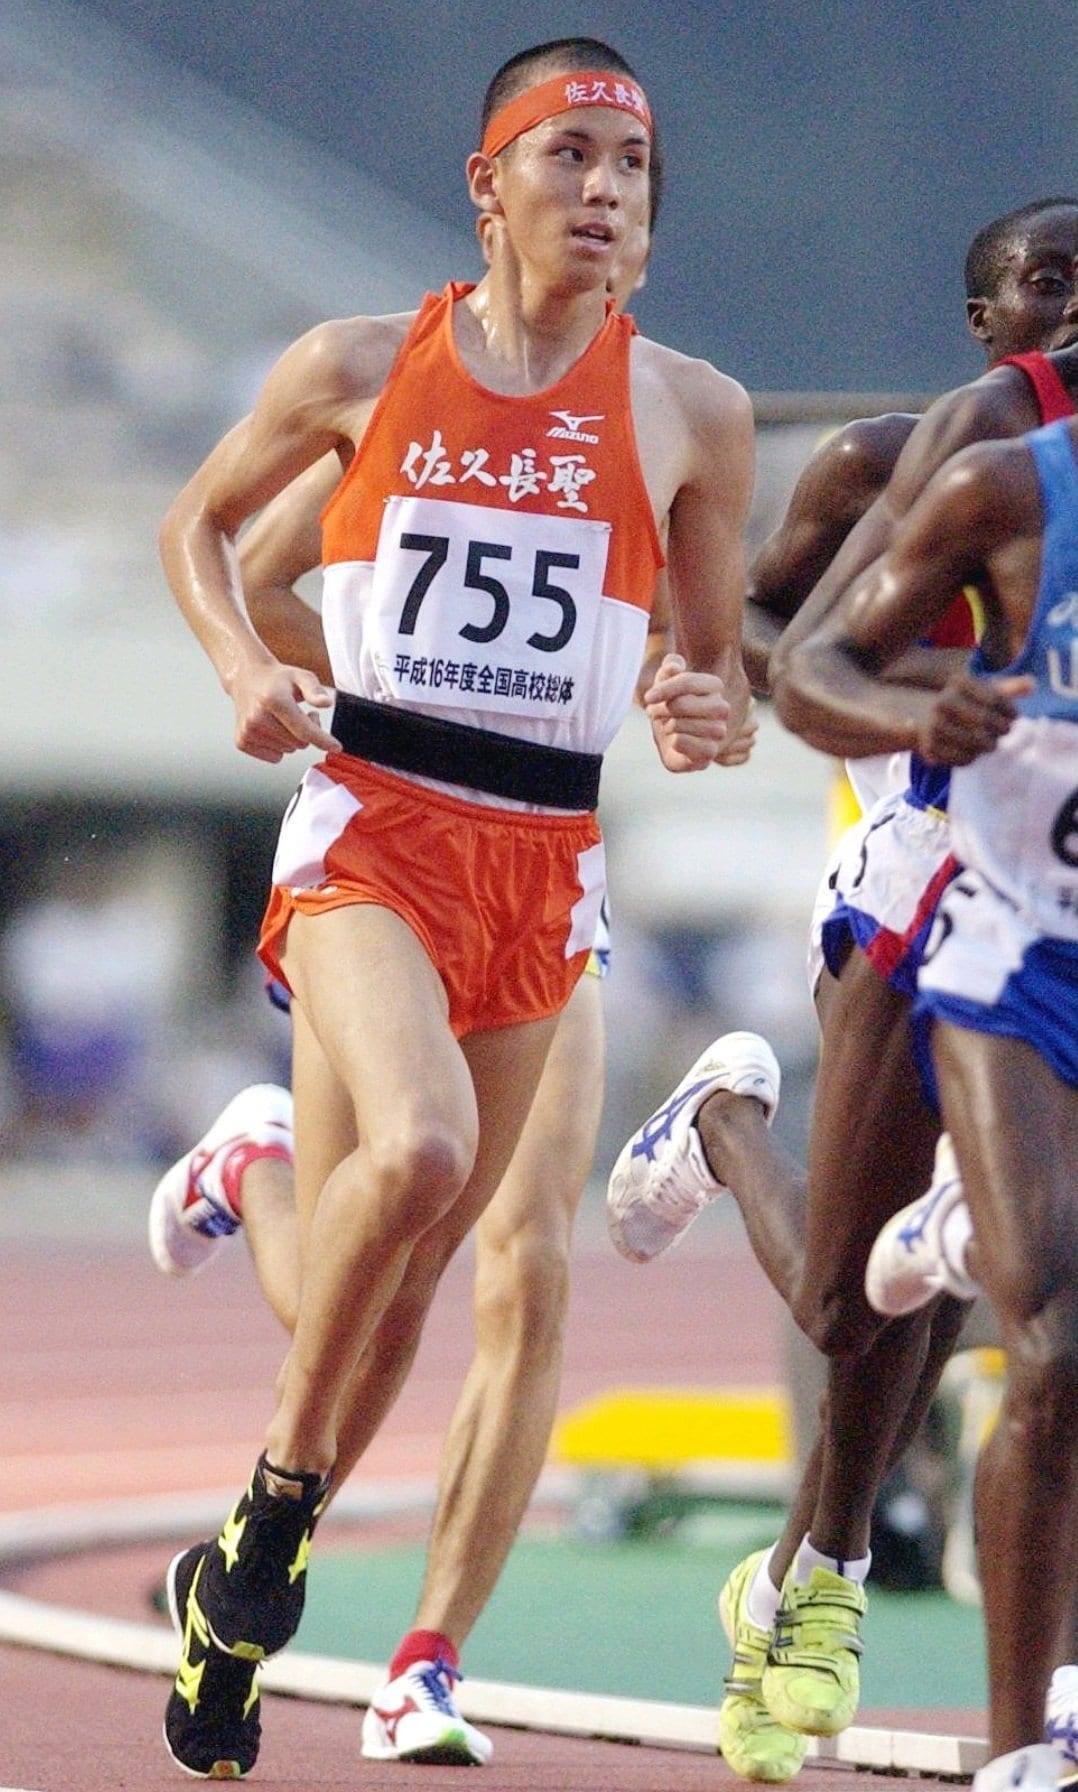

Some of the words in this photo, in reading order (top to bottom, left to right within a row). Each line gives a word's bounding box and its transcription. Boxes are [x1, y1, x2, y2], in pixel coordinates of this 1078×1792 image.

[400, 430, 596, 513] 佐久長聖
[398, 533, 580, 652] 755
[393, 654, 575, 705] 平成16年度全国高校総体
